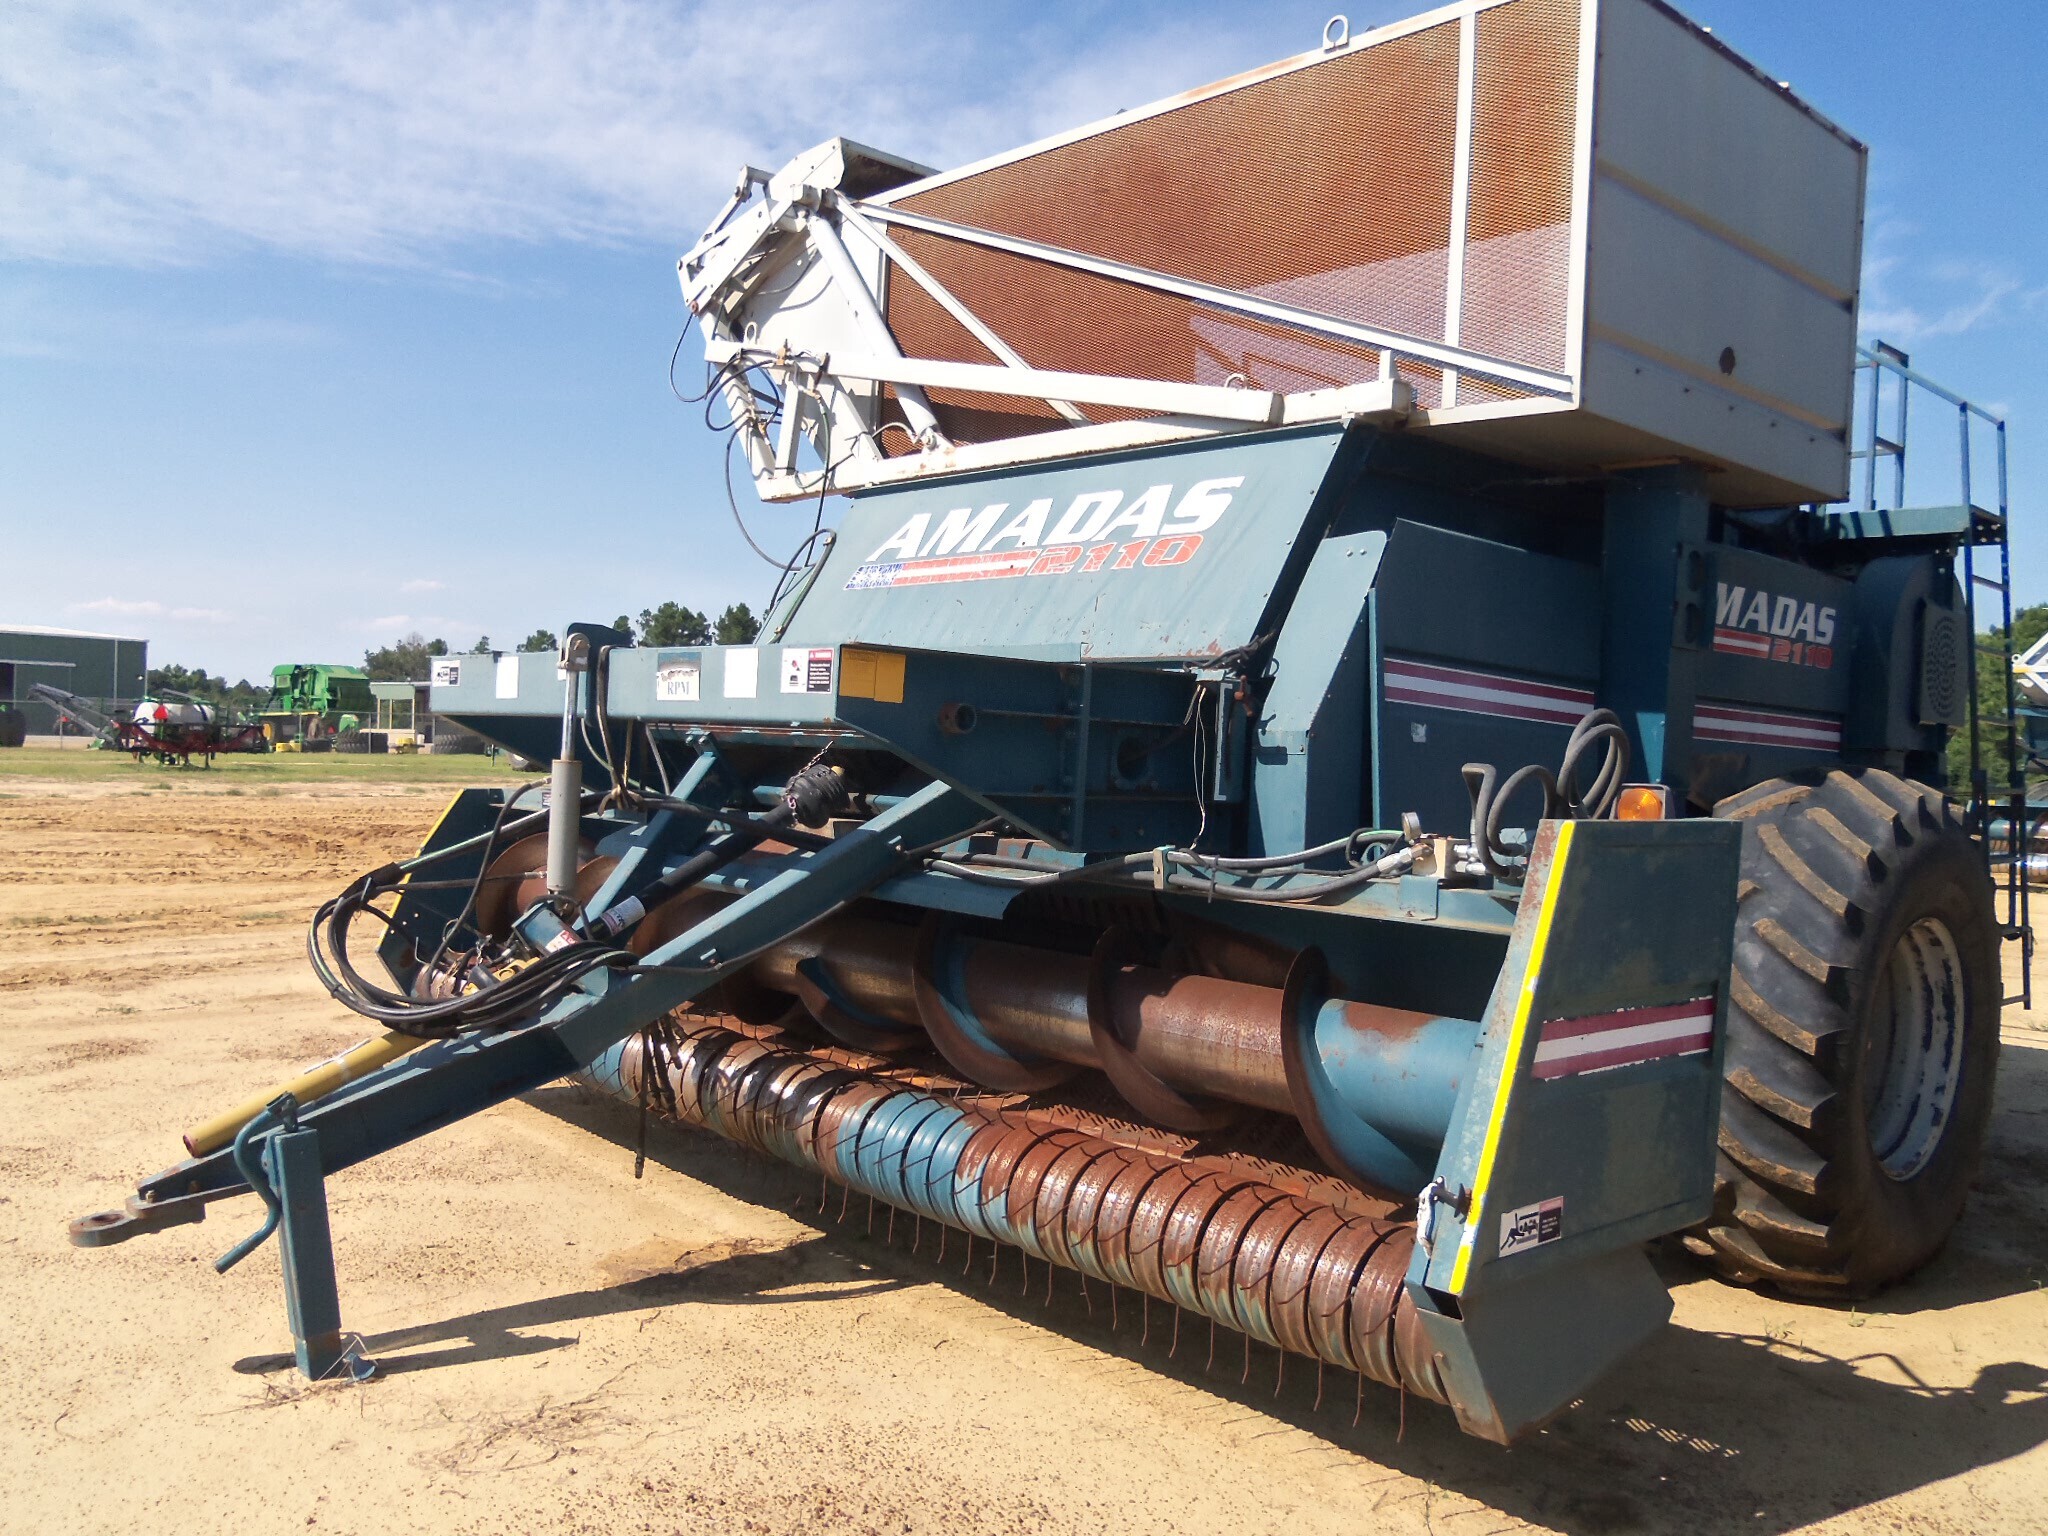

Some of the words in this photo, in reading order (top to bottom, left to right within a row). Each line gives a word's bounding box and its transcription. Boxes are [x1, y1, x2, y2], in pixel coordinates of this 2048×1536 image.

[865, 475, 1246, 562] AMADAS
[1026, 533, 1204, 576] 2110
[1715, 581, 1837, 646] MADAS
[667, 681, 690, 696] RPM
